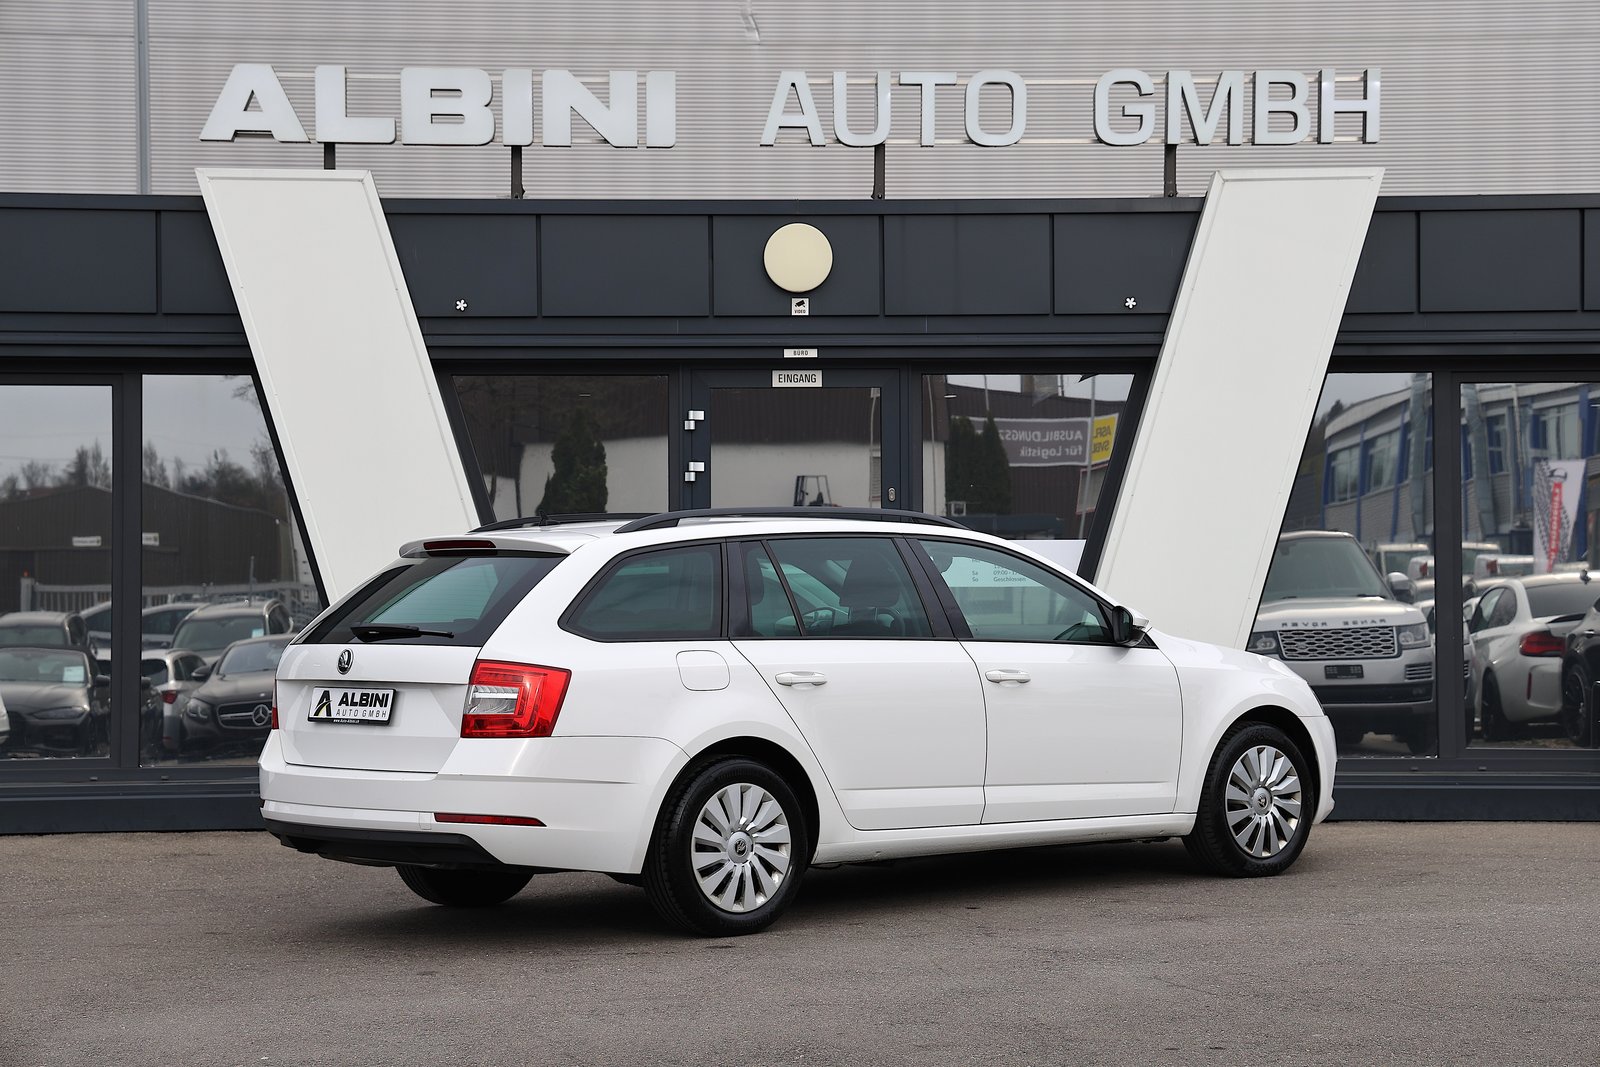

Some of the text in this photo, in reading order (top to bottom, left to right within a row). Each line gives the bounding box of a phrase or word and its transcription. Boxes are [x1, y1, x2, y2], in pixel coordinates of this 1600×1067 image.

[199, 63, 1382, 149] ALBINI AUTO GMBH
[778, 373, 817, 383] EINGANG
[337, 692, 390, 708] ALBINI
[336, 708, 387, 718] AUTO GMBH
